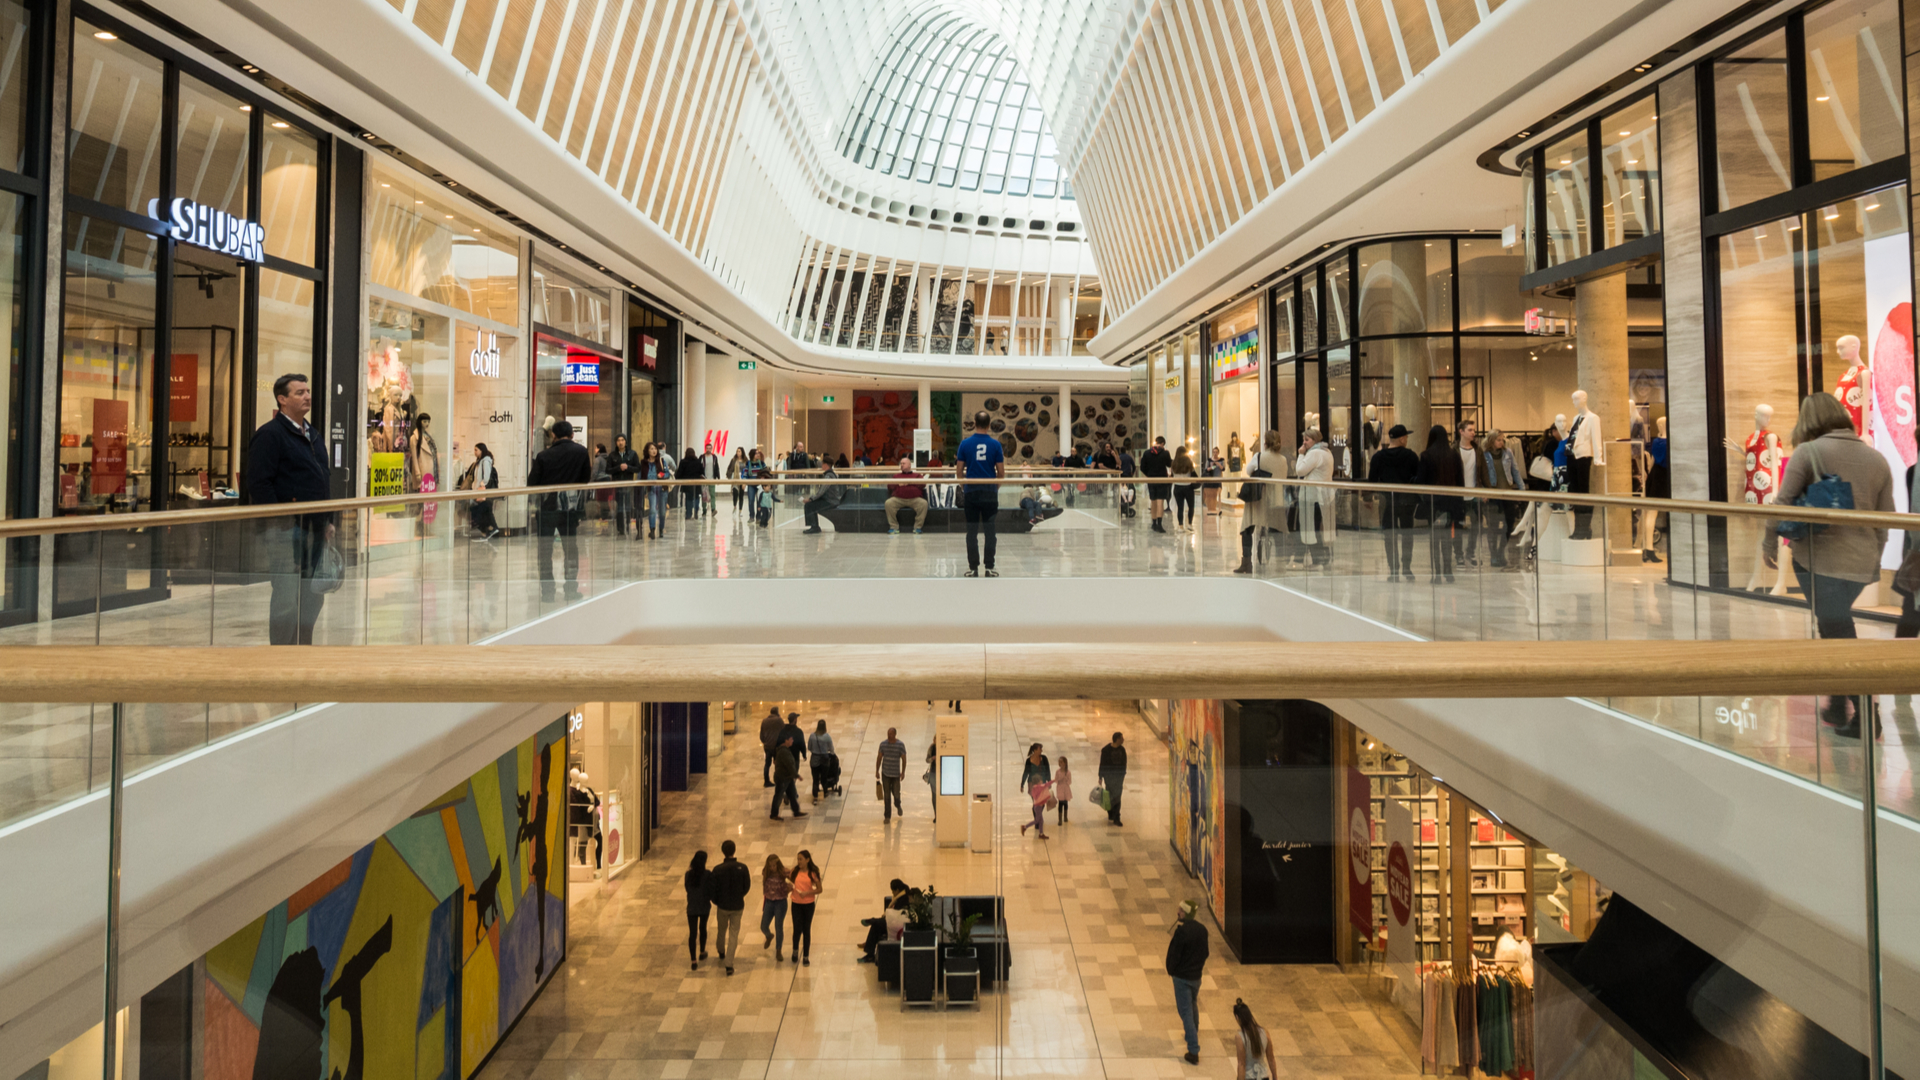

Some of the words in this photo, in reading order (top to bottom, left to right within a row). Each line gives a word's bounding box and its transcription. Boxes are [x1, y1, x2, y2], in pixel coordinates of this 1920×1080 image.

[174, 198, 265, 262] SHUBAR
[470, 330, 500, 378] dotti
[579, 364, 597, 375] Just
[576, 372, 599, 383] Jeans
[489, 411, 513, 423] dotti
[103, 430, 117, 438] SALE
[1333, 434, 1347, 447] SALE
[976, 443, 987, 461] 2
[374, 469, 388, 483] 30%
[390, 468, 403, 482] OFF
[1754, 473, 1768, 487] SALE
[374, 485, 402, 496] REDUCED
[1352, 840, 1369, 869] SALE
[1390, 878, 1410, 910] SALE
